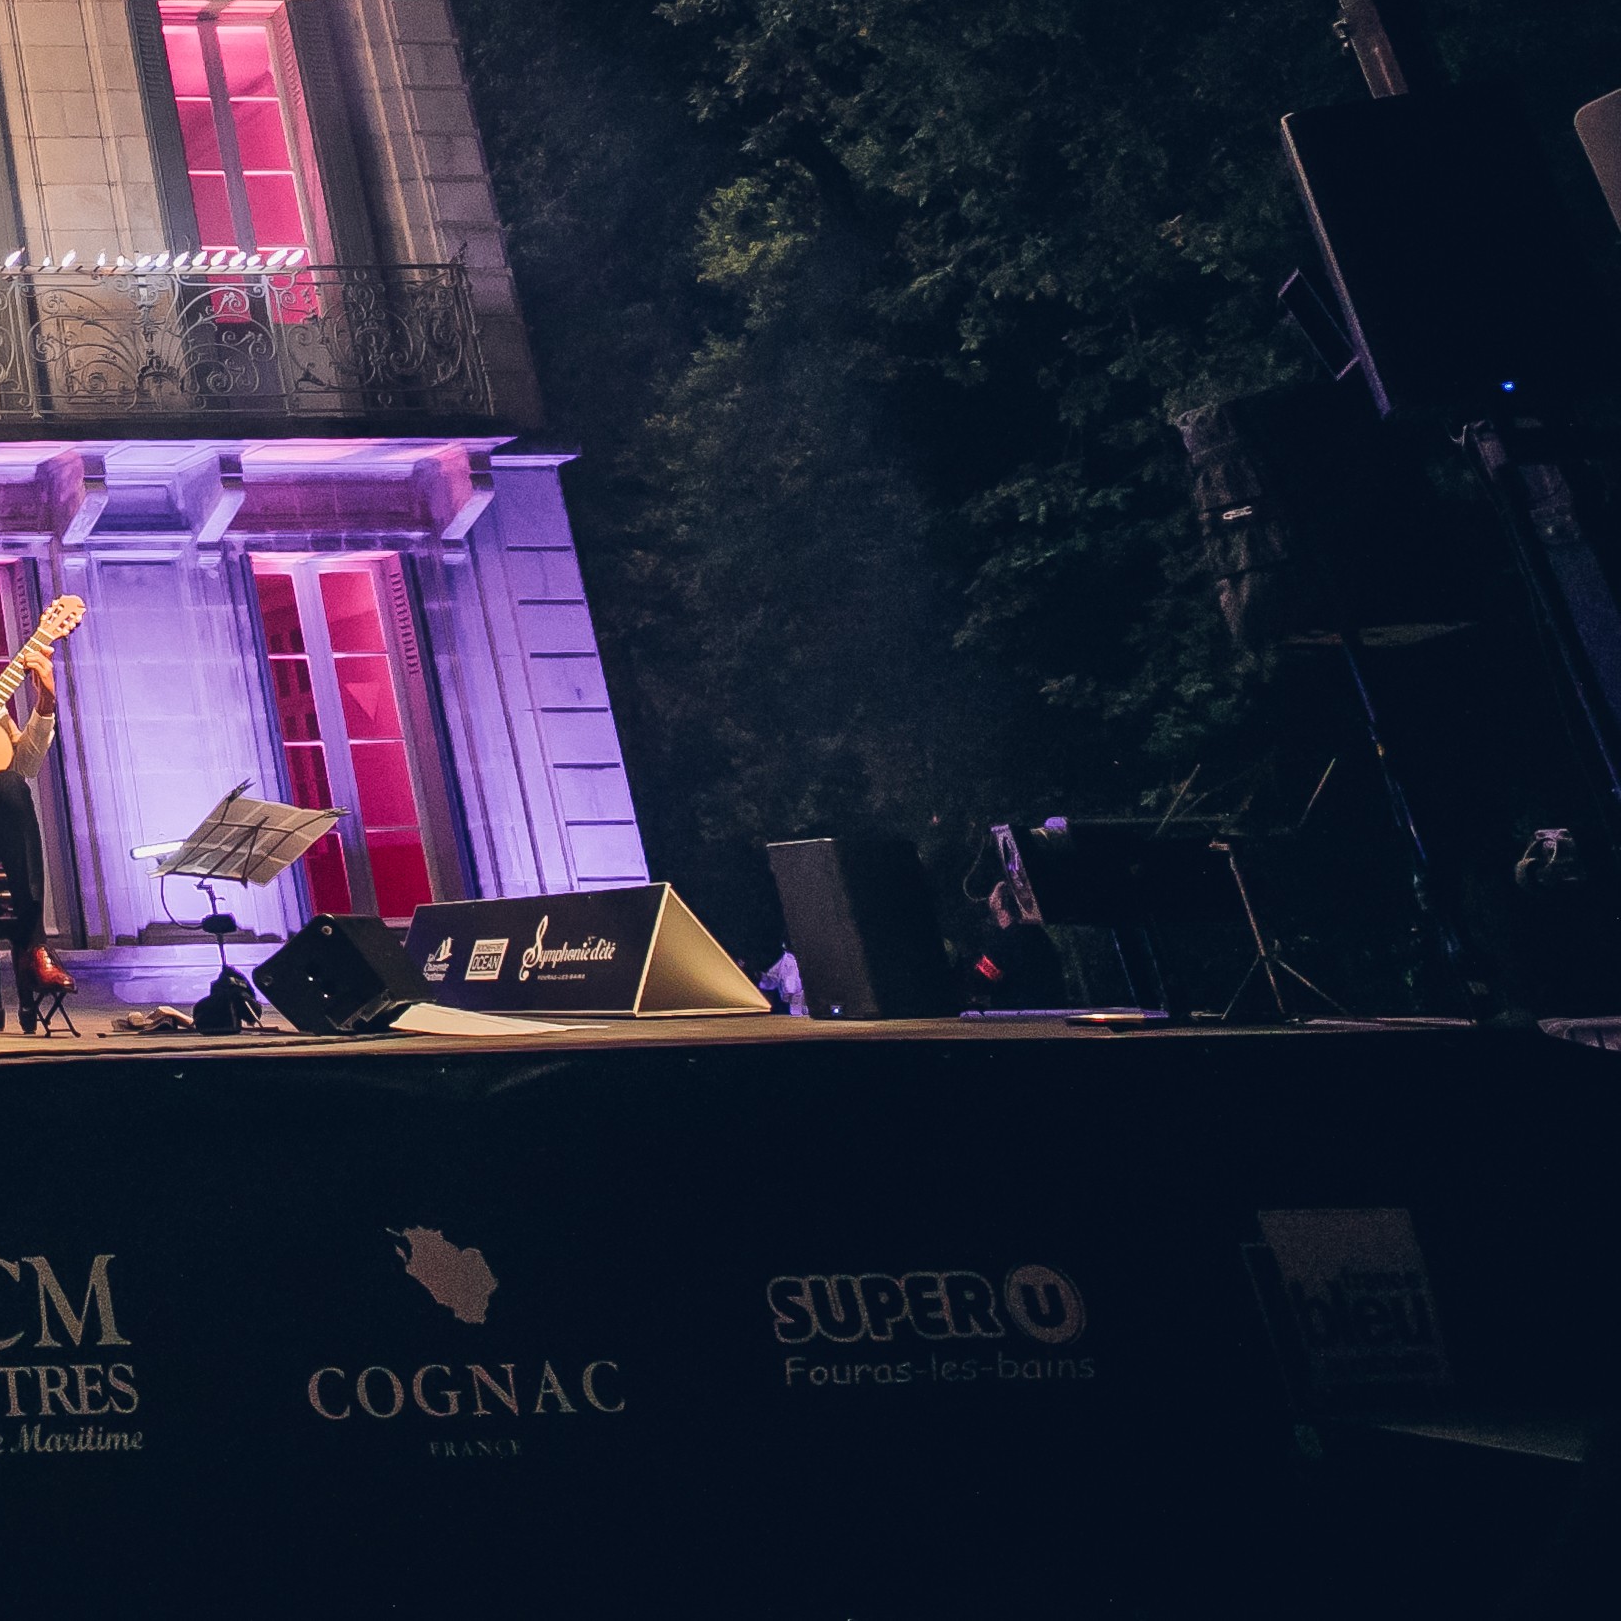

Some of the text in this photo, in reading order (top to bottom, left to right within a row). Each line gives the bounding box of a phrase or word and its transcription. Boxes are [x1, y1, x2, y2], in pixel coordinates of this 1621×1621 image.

[519, 914, 590, 981] Symphonie
[766, 1270, 1006, 1345] SUPER
[307, 1359, 626, 1421] COGNAC
[784, 1351, 1096, 1387] Fouras-les-bains
[9, 1423, 144, 1455] Maritime
[428, 1438, 525, 1459] FRANCE
